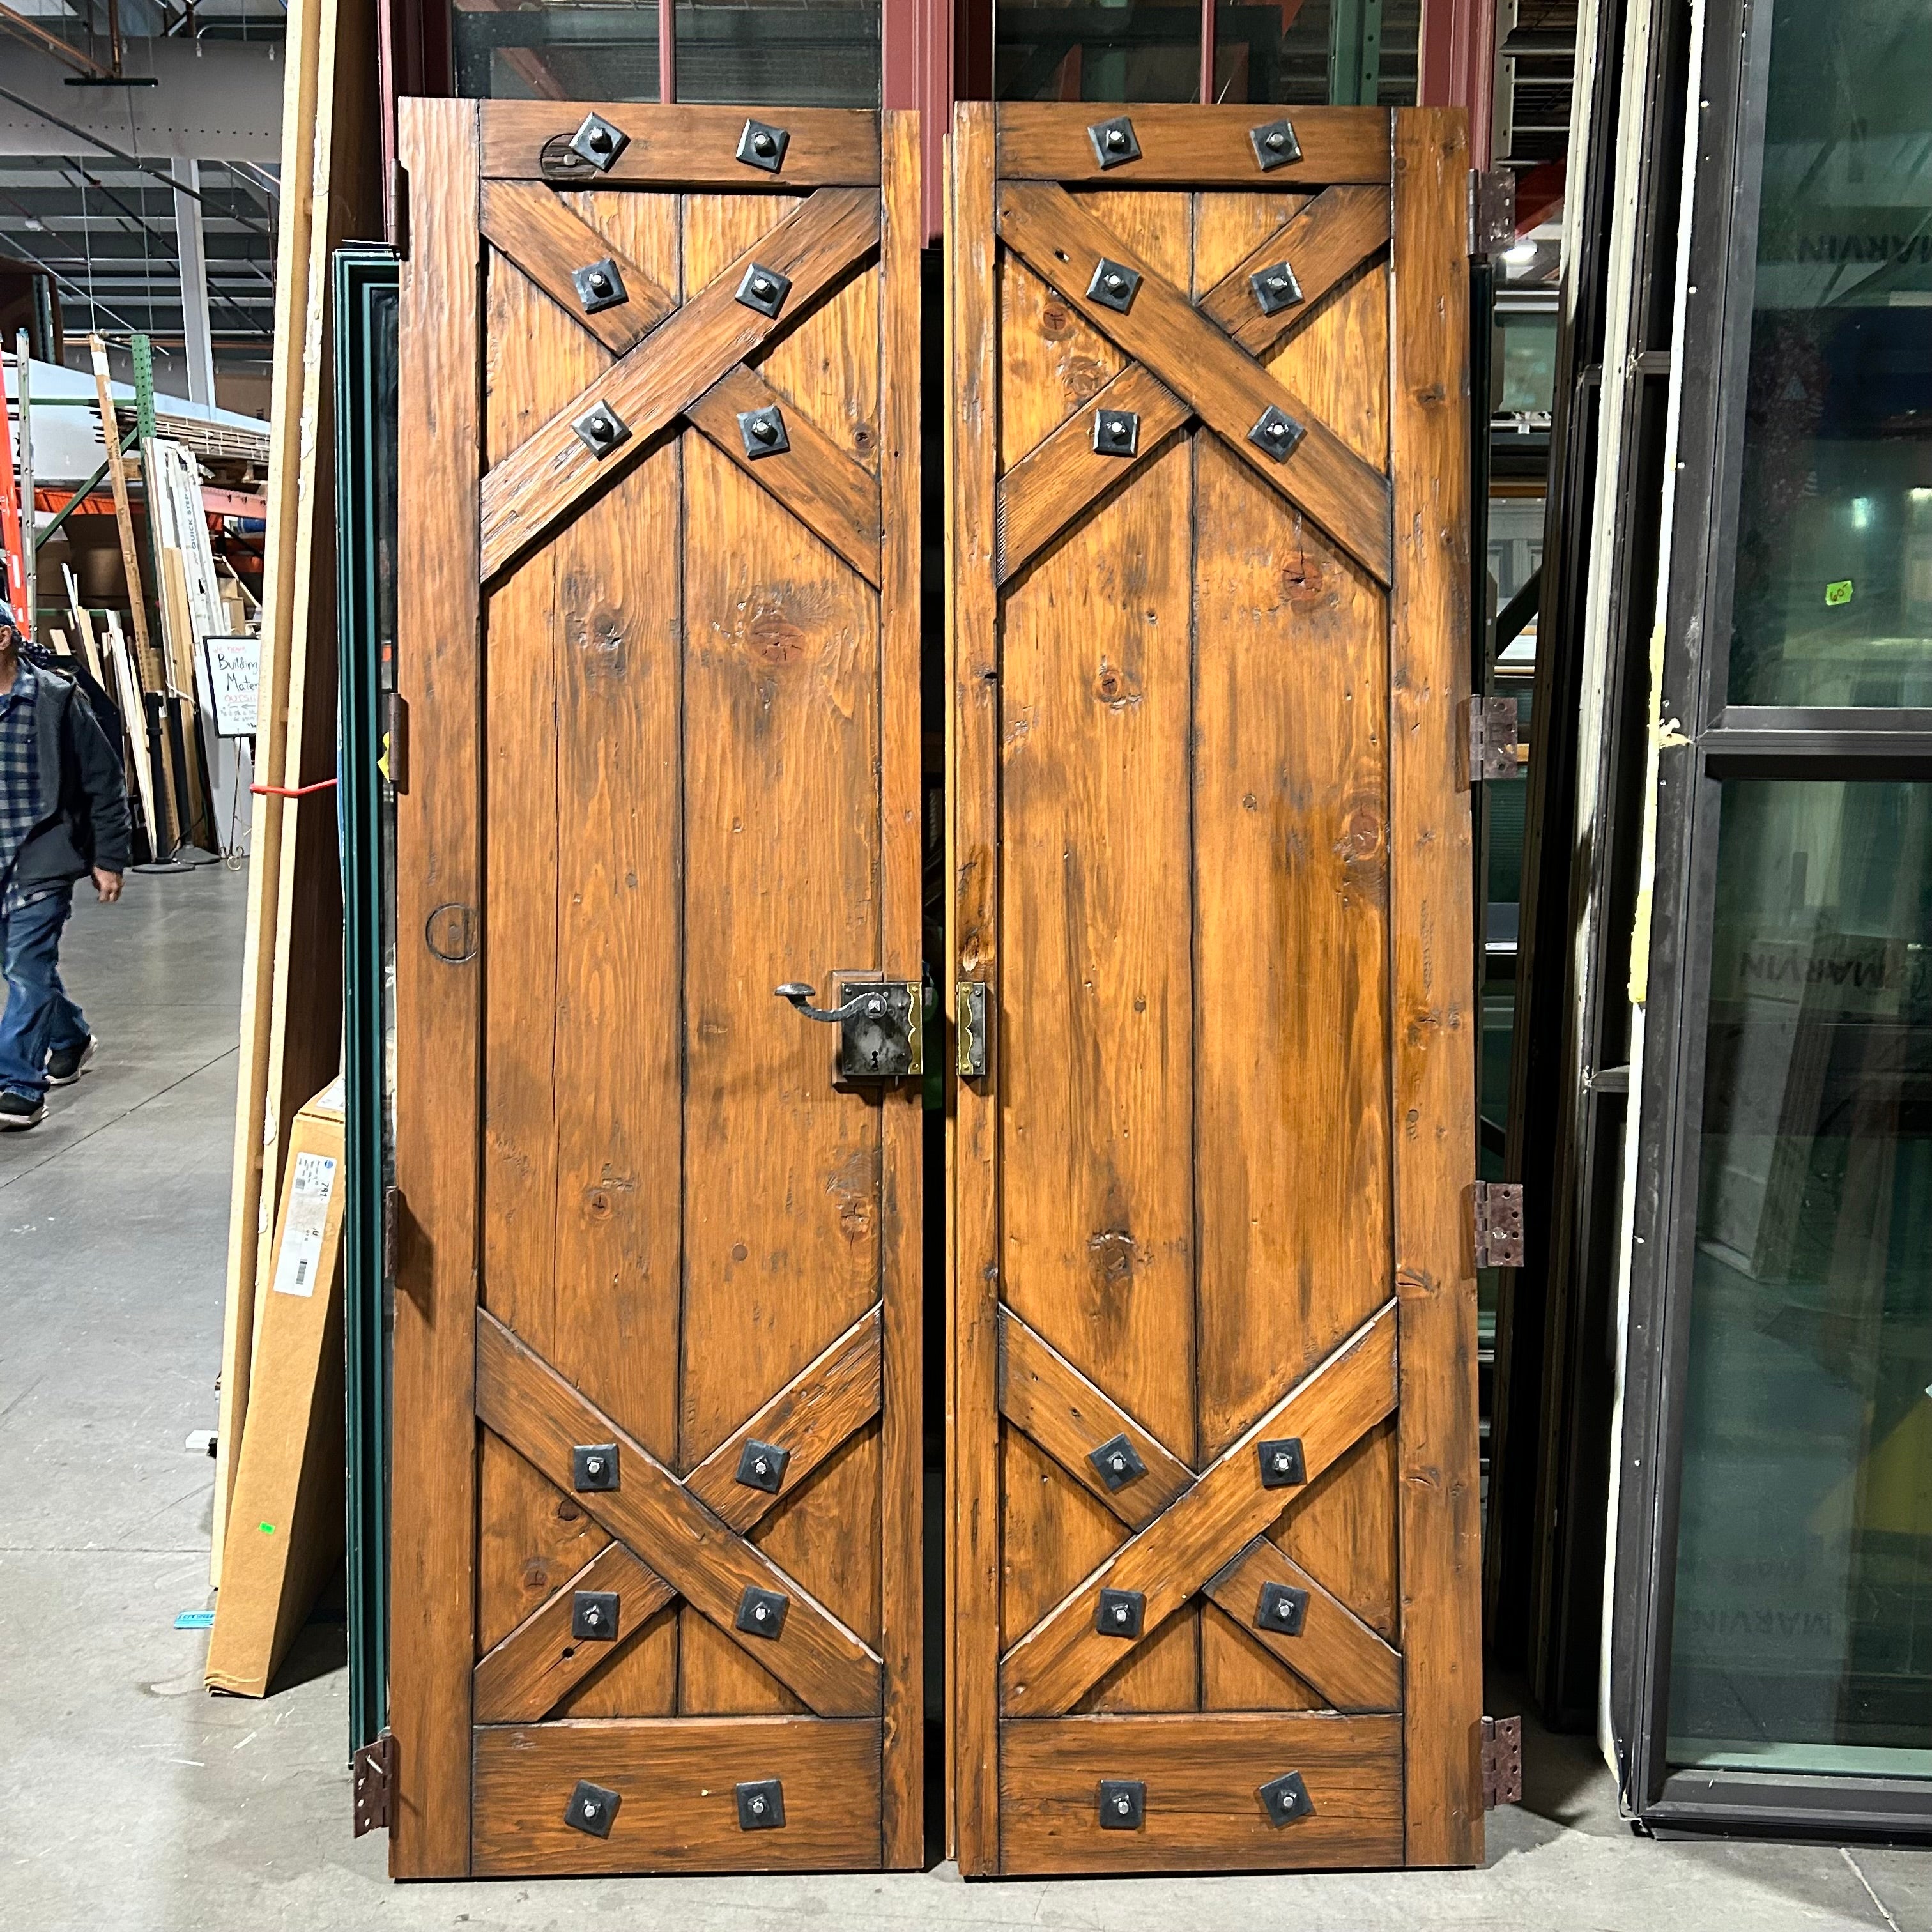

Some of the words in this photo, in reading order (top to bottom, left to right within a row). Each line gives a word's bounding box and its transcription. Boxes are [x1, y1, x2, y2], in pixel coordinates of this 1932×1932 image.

[188, 519, 197, 550] QUICK
[218, 653, 258, 675] Building
[1739, 951, 1886, 988] MARVIN
